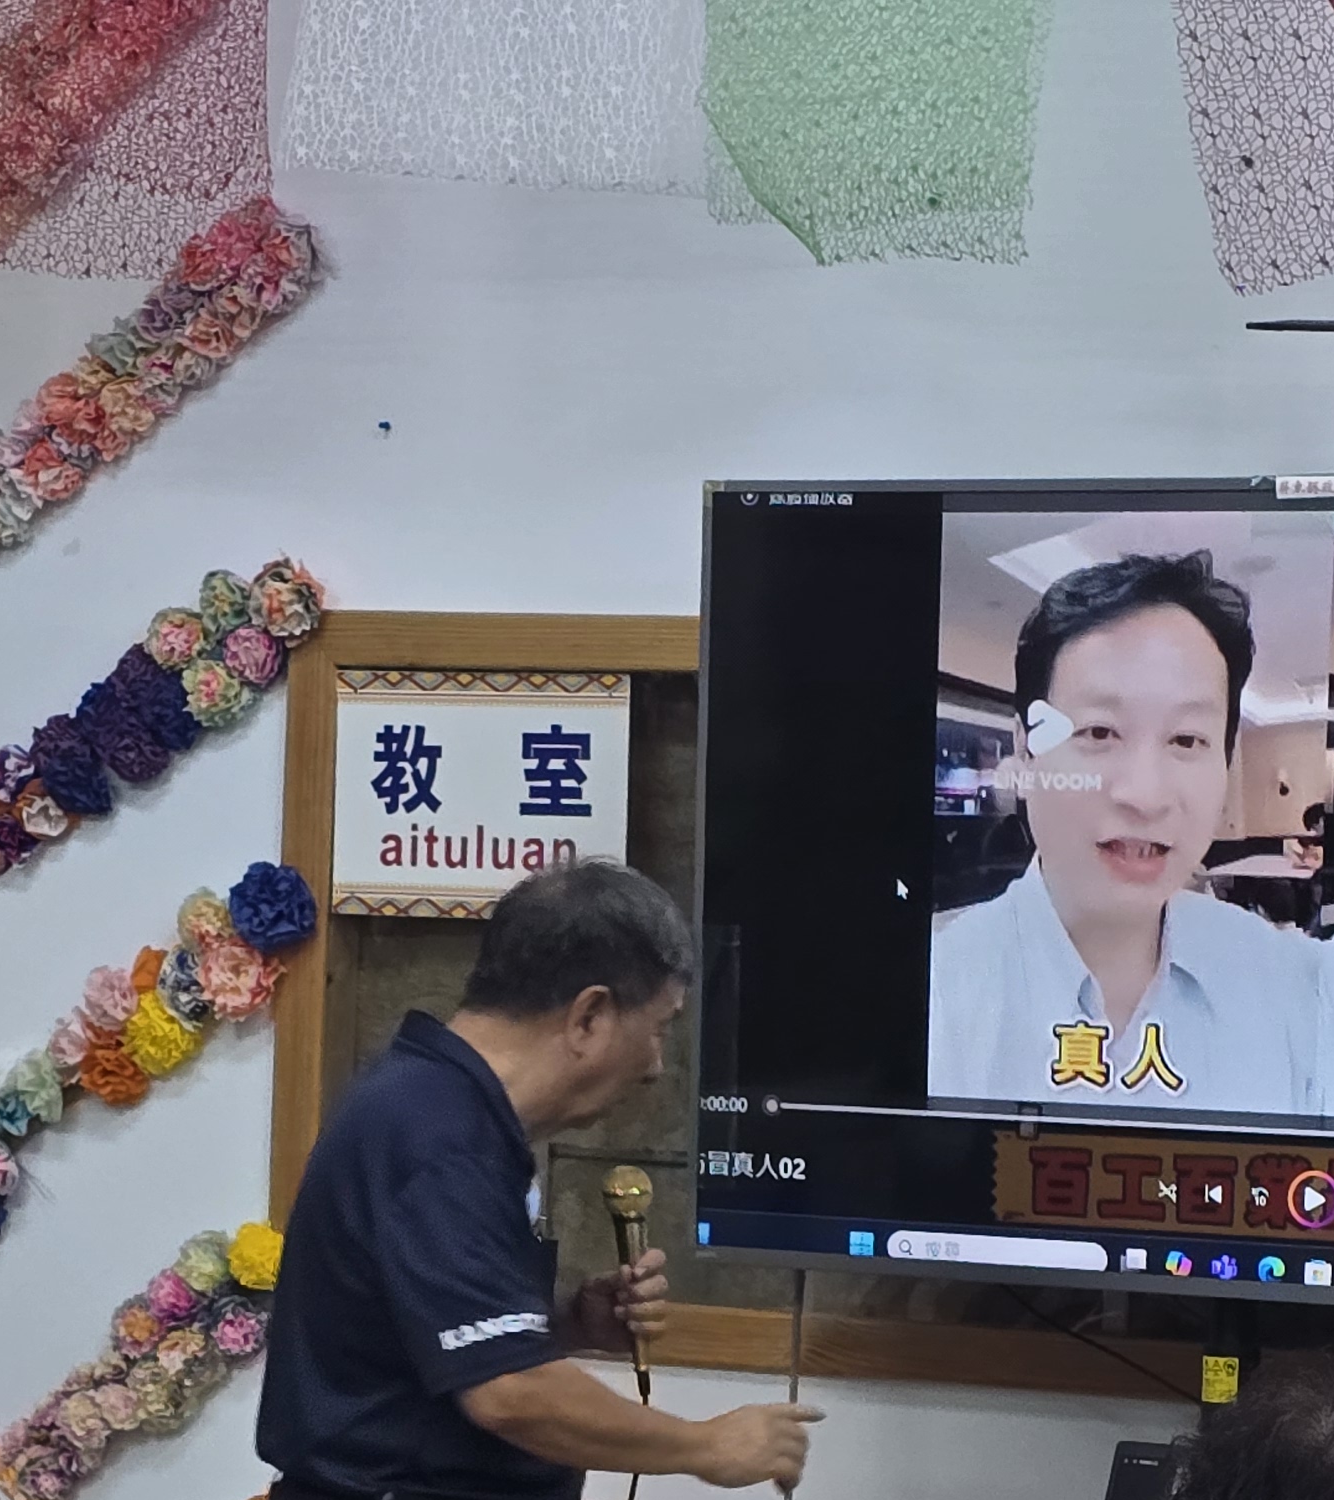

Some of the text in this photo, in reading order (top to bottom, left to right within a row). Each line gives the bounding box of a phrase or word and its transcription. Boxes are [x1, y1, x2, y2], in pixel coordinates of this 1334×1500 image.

[371, 724, 592, 817] 教室
[1039, 773, 1103, 791] VOOM
[380, 823, 577, 870] aituluan
[1051, 1020, 1184, 1091] 真人
